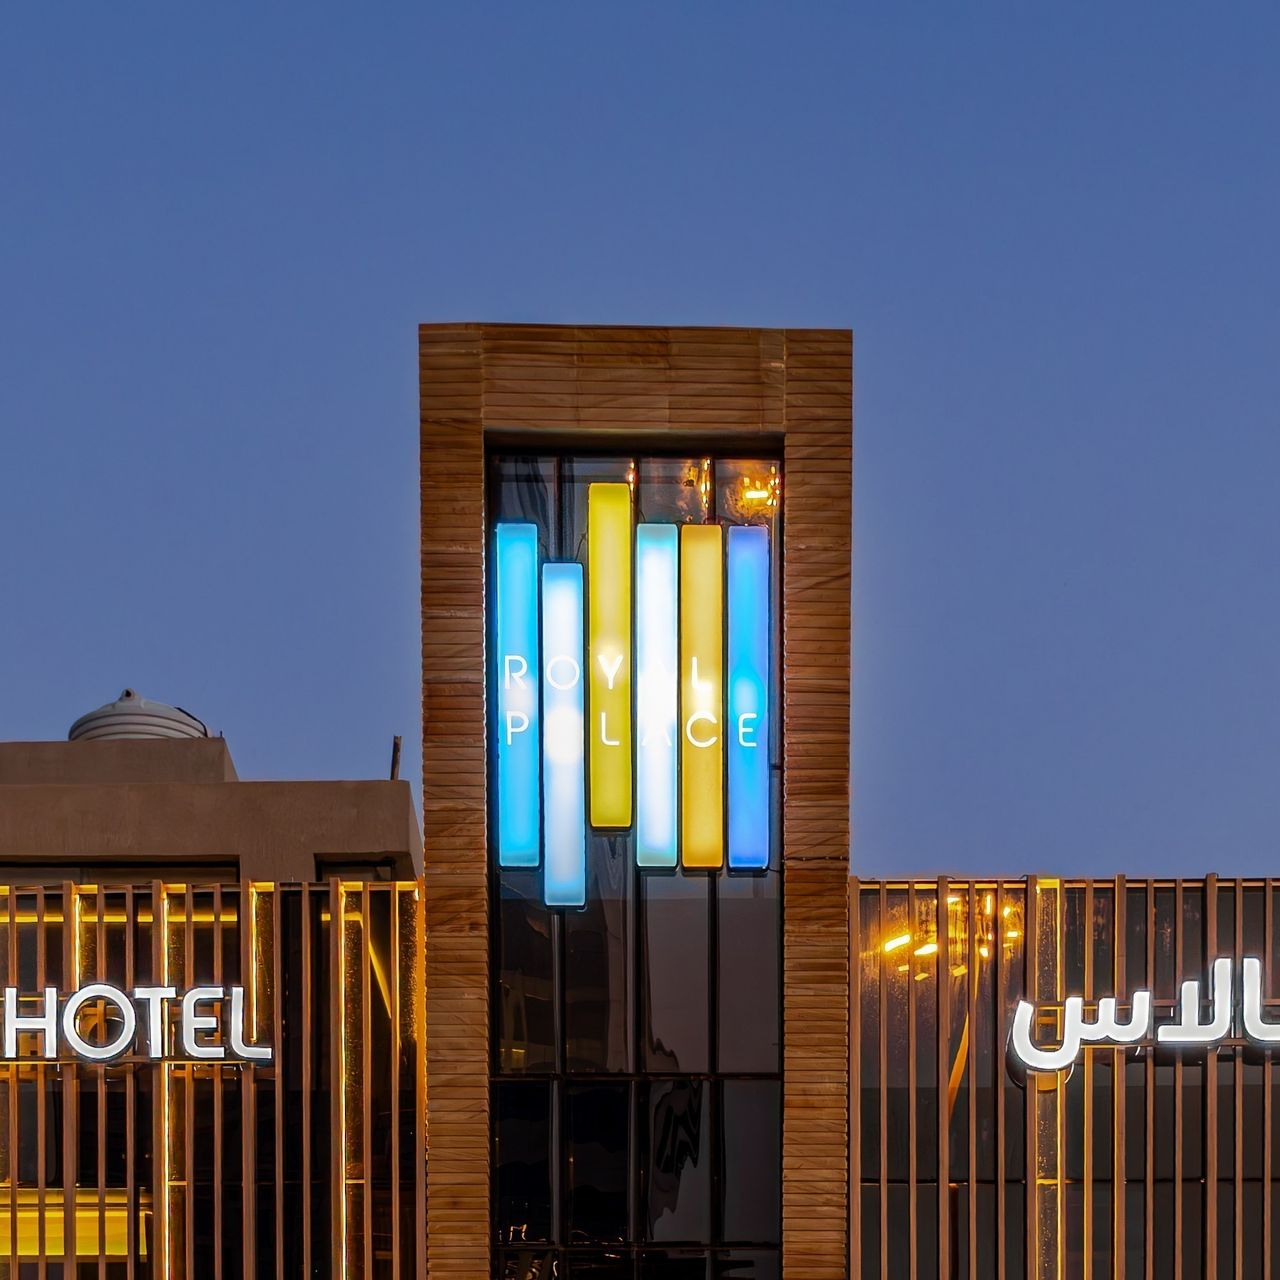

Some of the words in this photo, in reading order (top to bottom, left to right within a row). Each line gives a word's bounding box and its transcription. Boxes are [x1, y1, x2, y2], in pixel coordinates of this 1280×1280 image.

[504, 655, 711, 690] ROYL
[506, 710, 757, 748] PLCE
[4, 983, 272, 1059] HOTEL
